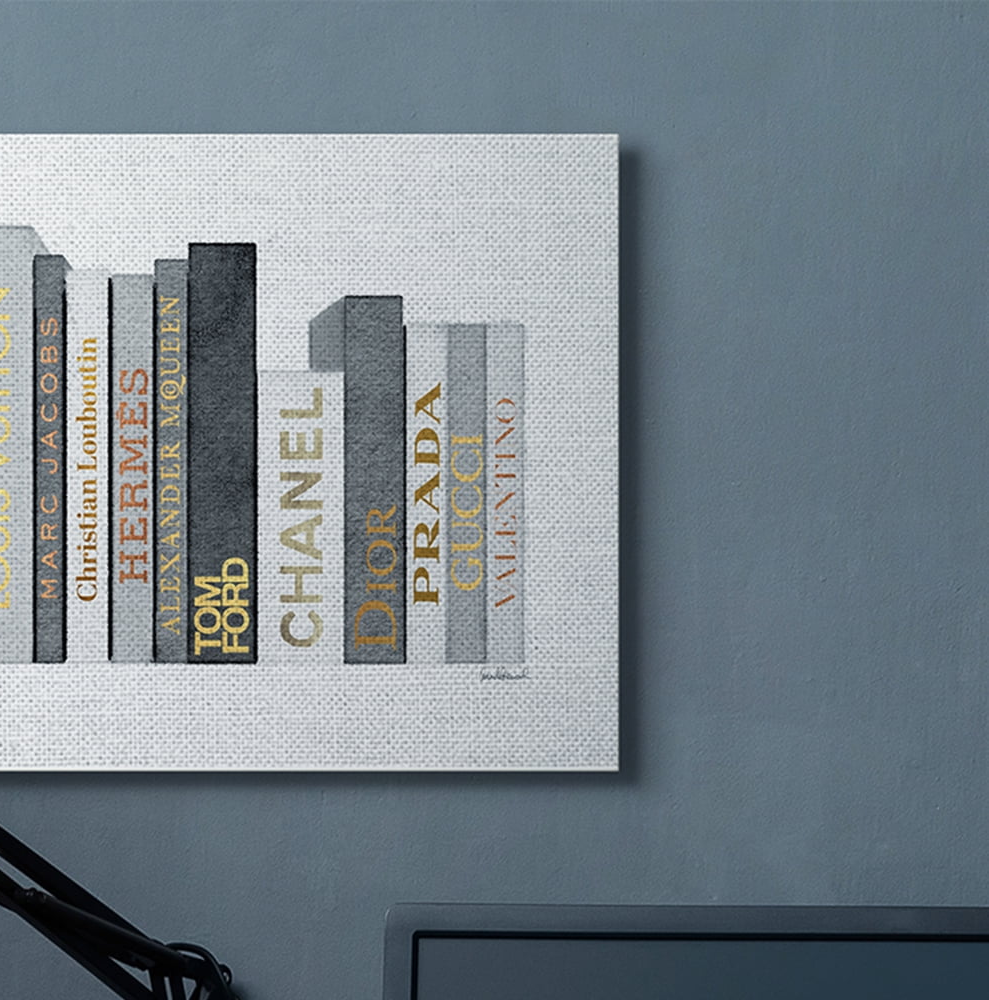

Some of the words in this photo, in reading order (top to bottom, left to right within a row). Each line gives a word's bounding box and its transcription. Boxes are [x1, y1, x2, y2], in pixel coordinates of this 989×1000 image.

[41, 316, 59, 475] JACOBS
[76, 337, 98, 468] Louboutin
[41, 494, 59, 599] MARC
[76, 478, 98, 602] Christian
[160, 442, 181, 635] ALEXANDER
[280, 387, 323, 648] CHANEL
[413, 382, 442, 606] PRADA
[450, 434, 484, 591] GUCCI
[494, 398, 517, 609] VALENTINO
[194, 575, 221, 655] TOM
[222, 557, 250, 654] FORD
[354, 505, 397, 650] DIOR
